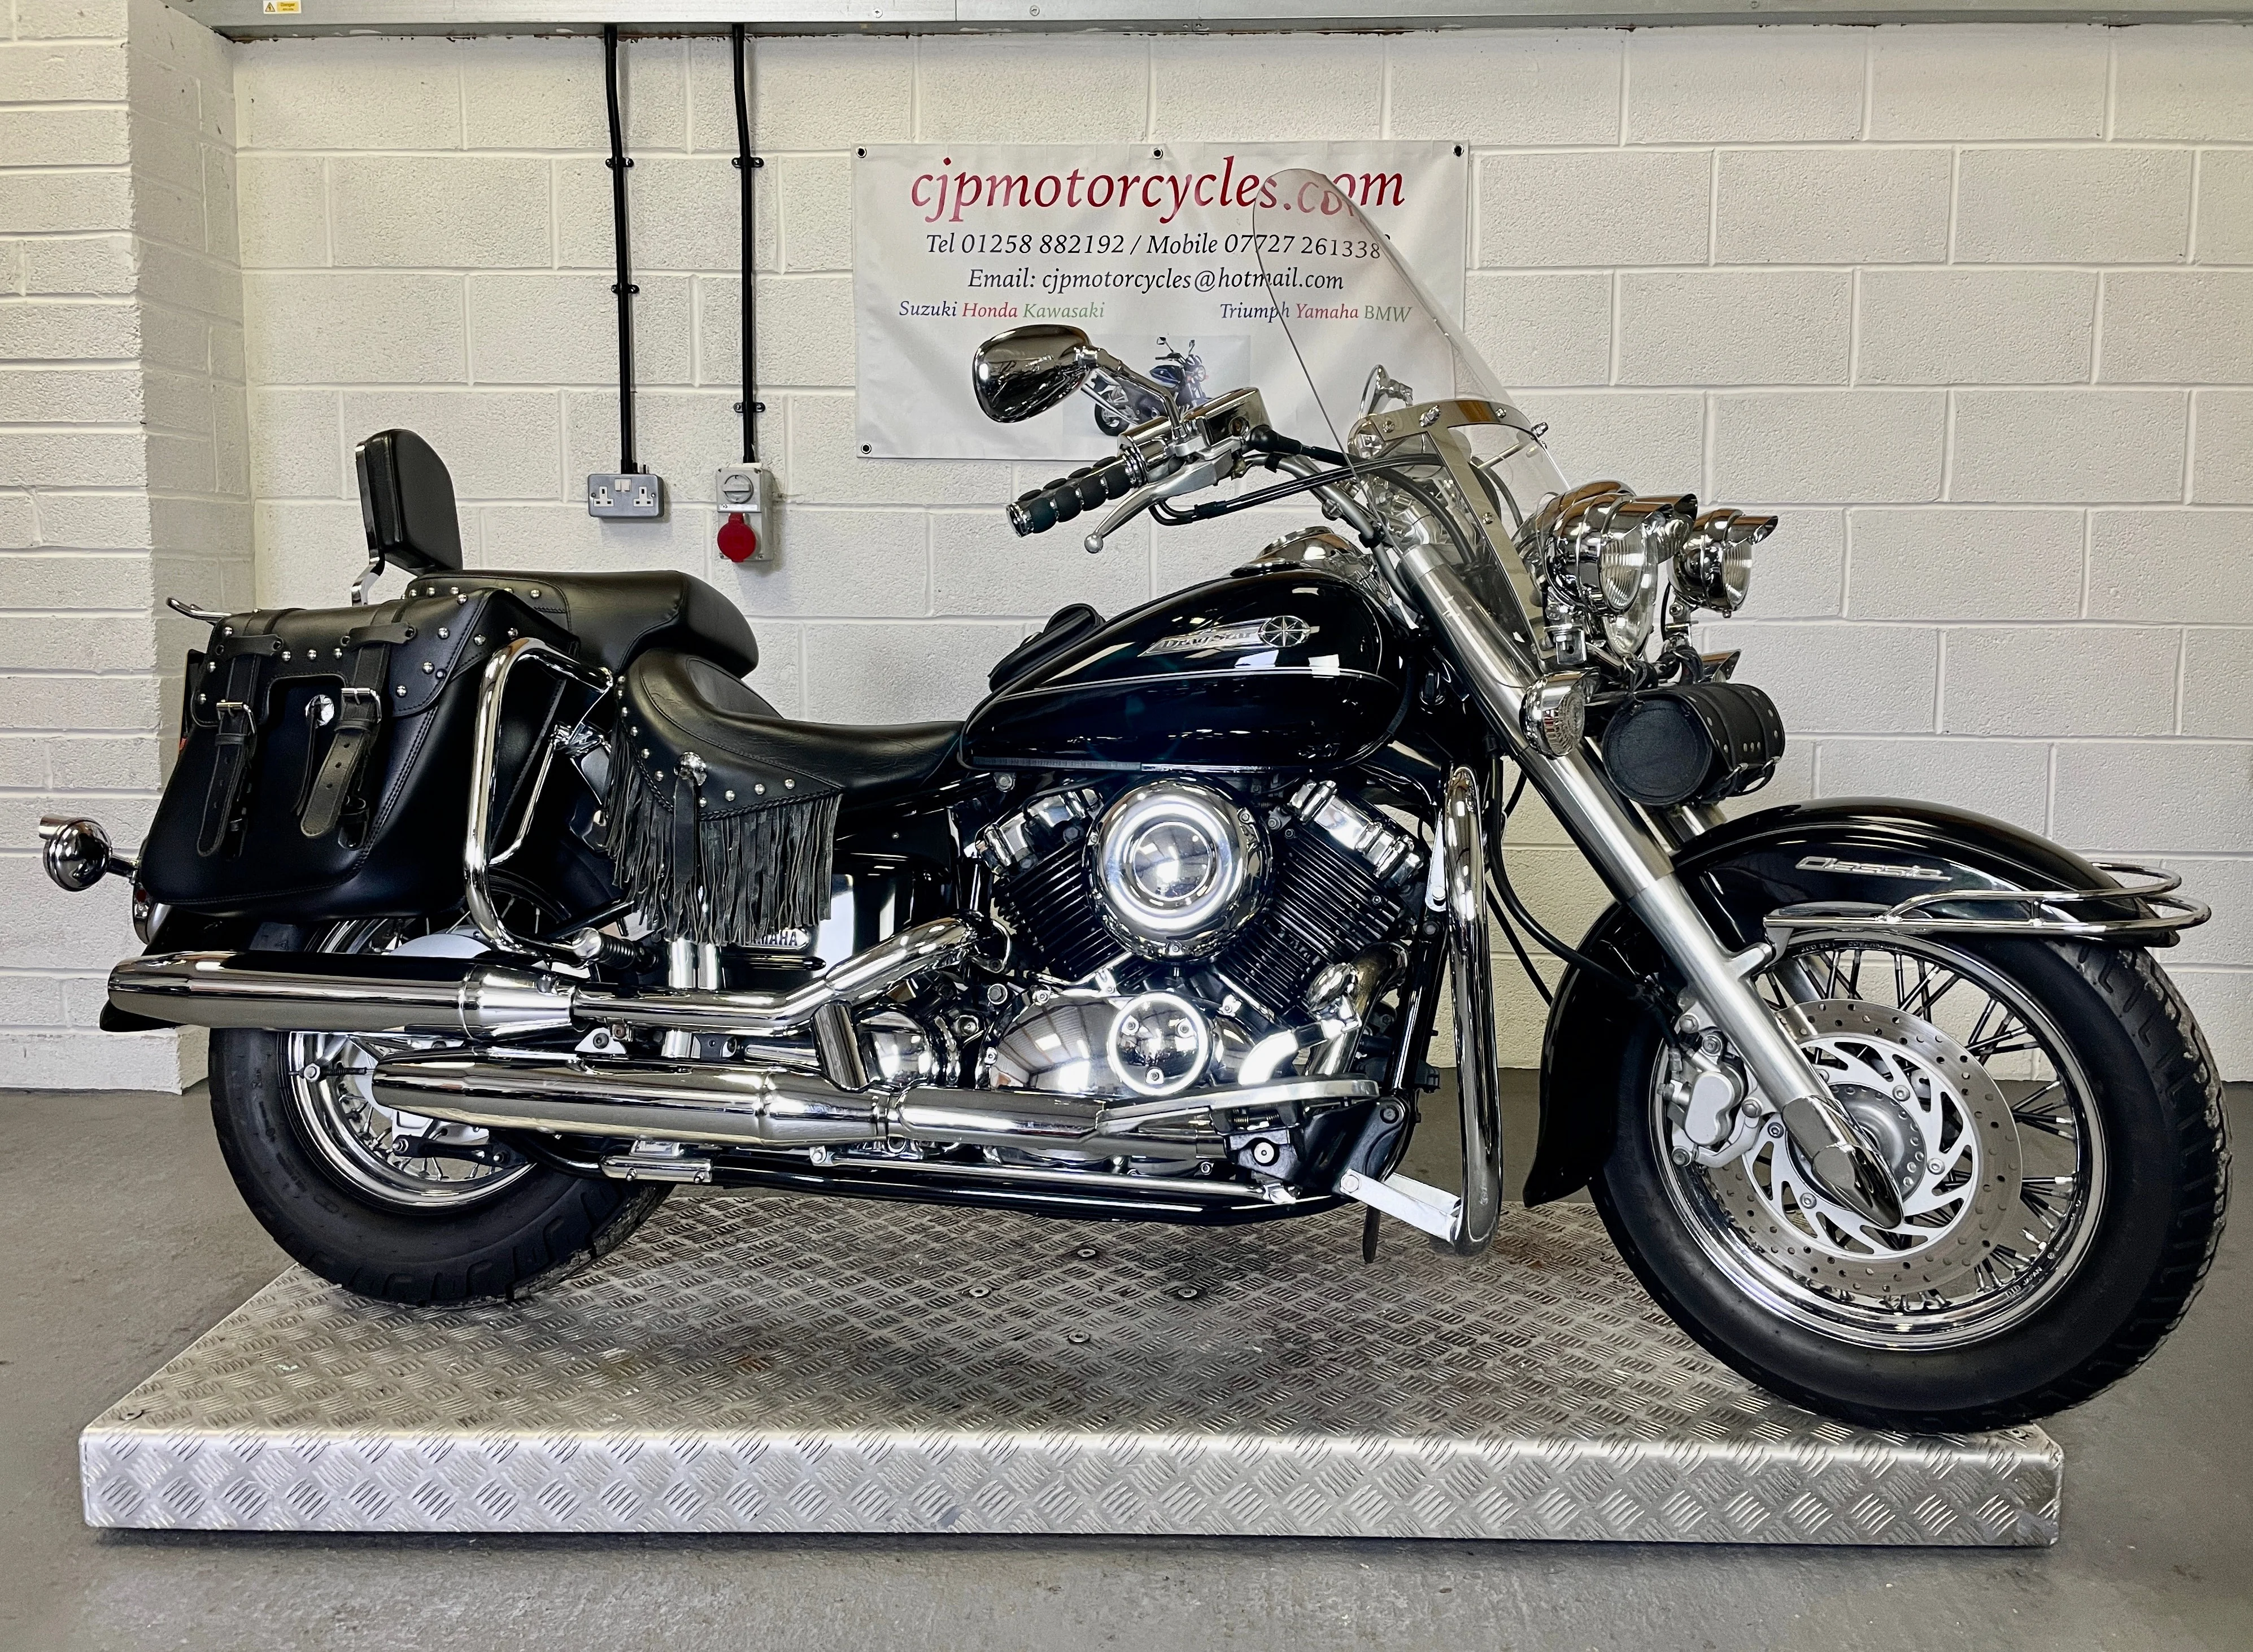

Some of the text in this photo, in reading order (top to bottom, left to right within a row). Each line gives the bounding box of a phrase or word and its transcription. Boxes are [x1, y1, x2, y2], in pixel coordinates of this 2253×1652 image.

[926, 232, 1381, 259] Tel 01258 882192 / Mobile 07727 261338
[968, 267, 1344, 293] Email: cjpmotorcycles@hotmail.com
[899, 300, 1105, 318] Suzuki Honda Kawasaki
[1220, 303, 1413, 322] Triumph Yamaha BMW
[2023, 1266, 2042, 1285] JAPAN
